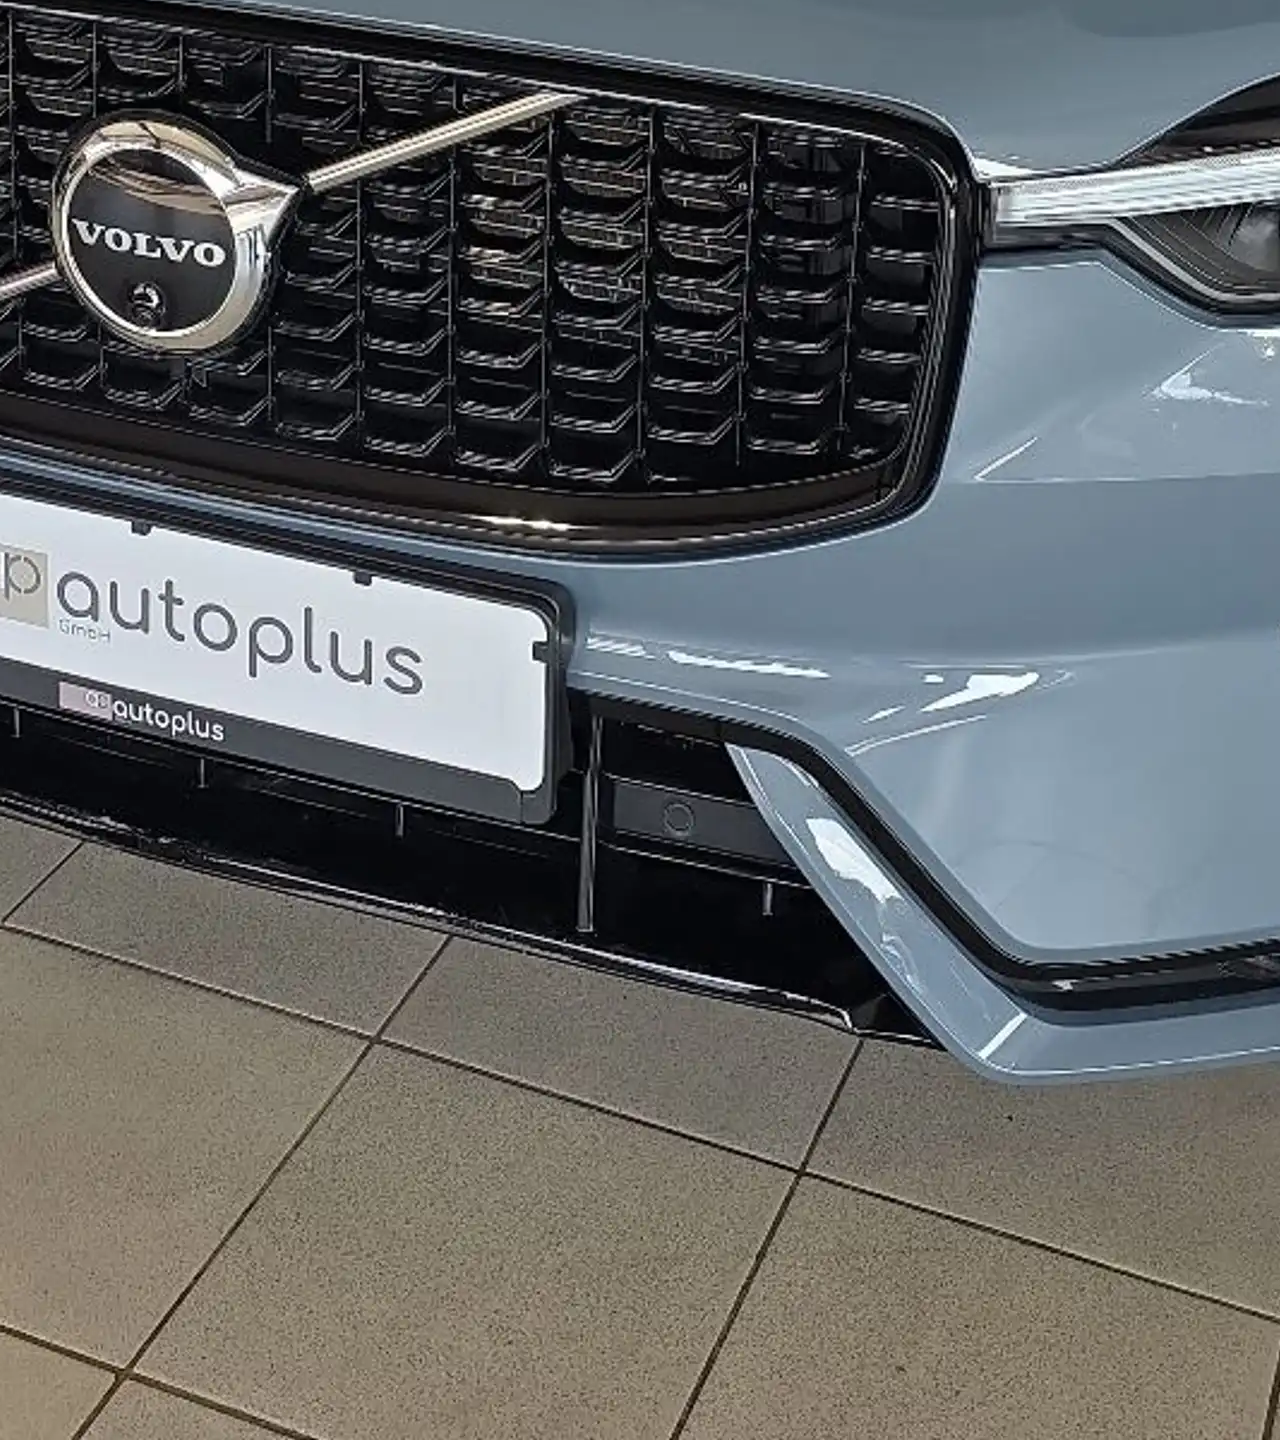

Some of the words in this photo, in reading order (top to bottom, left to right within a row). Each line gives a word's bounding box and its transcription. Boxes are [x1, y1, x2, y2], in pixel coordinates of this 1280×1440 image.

[71, 217, 227, 268] VOLVO
[56, 571, 423, 695] autoplus
[59, 619, 111, 644] GmbH
[113, 698, 225, 742] autoplus
